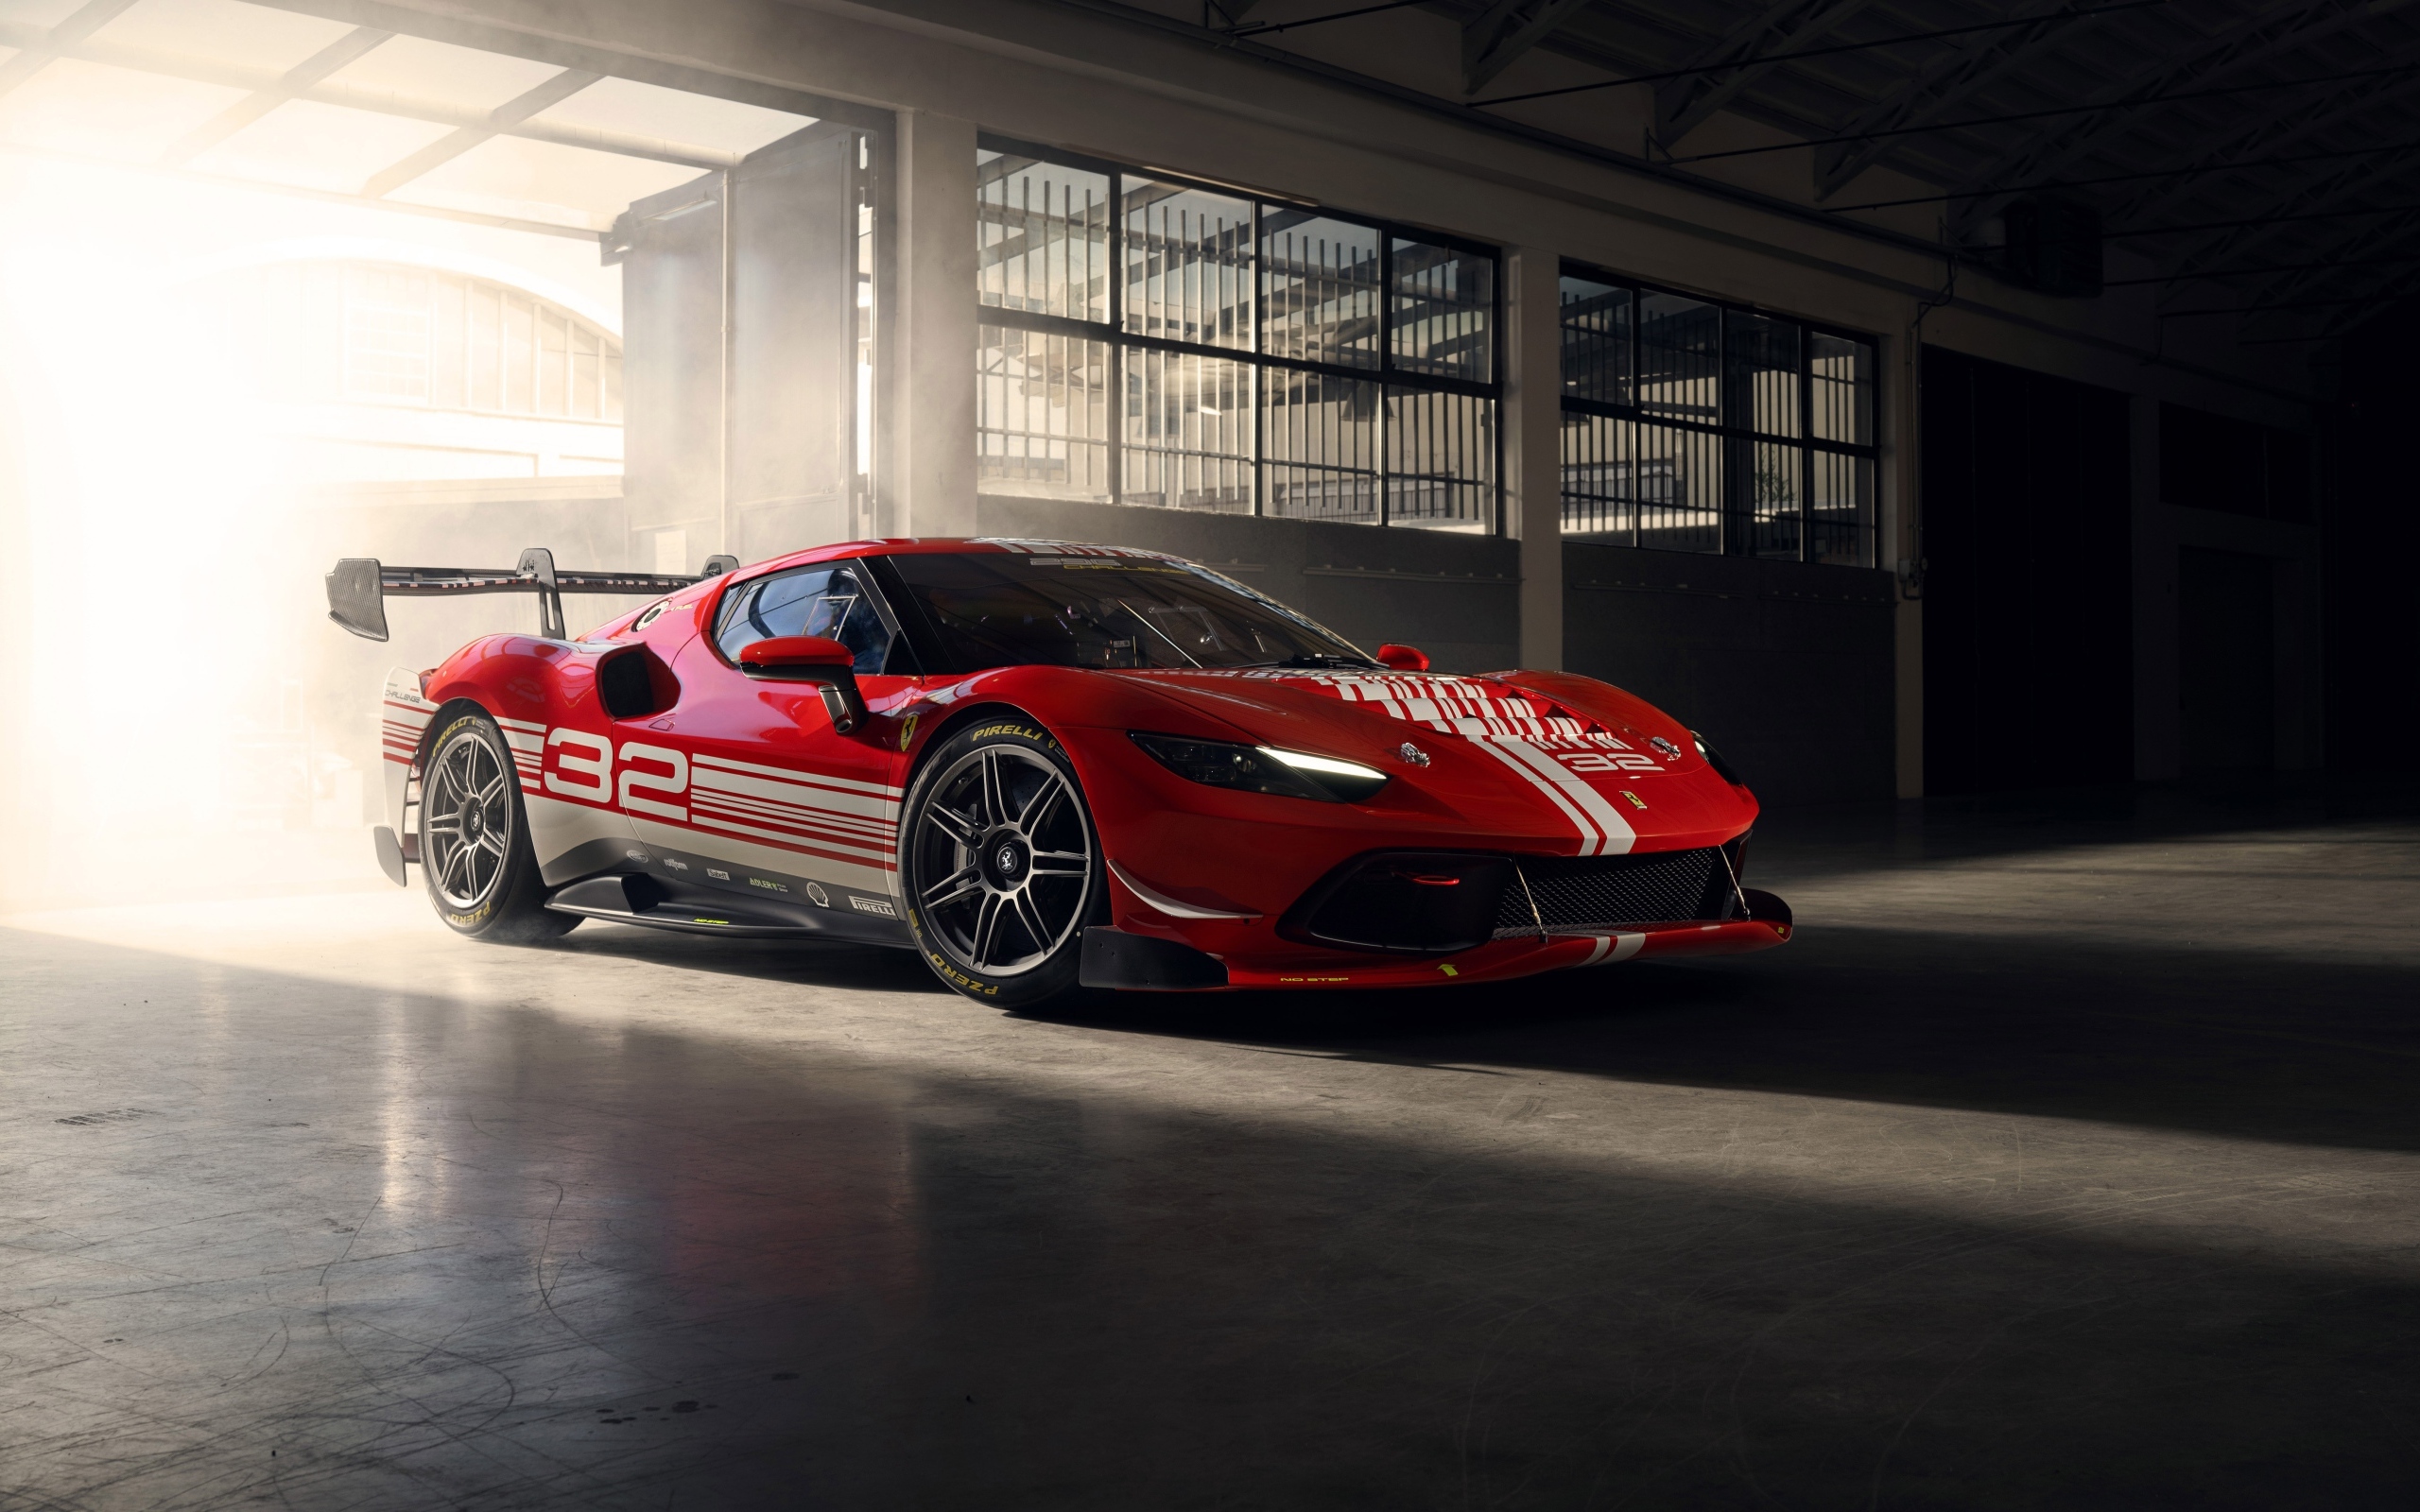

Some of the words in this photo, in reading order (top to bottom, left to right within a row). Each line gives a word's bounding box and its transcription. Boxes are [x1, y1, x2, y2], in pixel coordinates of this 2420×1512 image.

[1063, 565, 1191, 575] CHALLENGE
[385, 690, 421, 703] CHALLENGE
[433, 717, 468, 757] PIRELLI
[972, 725, 1043, 742] PIRELLI
[1557, 753, 1665, 771] 32
[544, 727, 688, 821] 32
[750, 877, 771, 890] ADLER
[848, 896, 896, 917] PIRELLI
